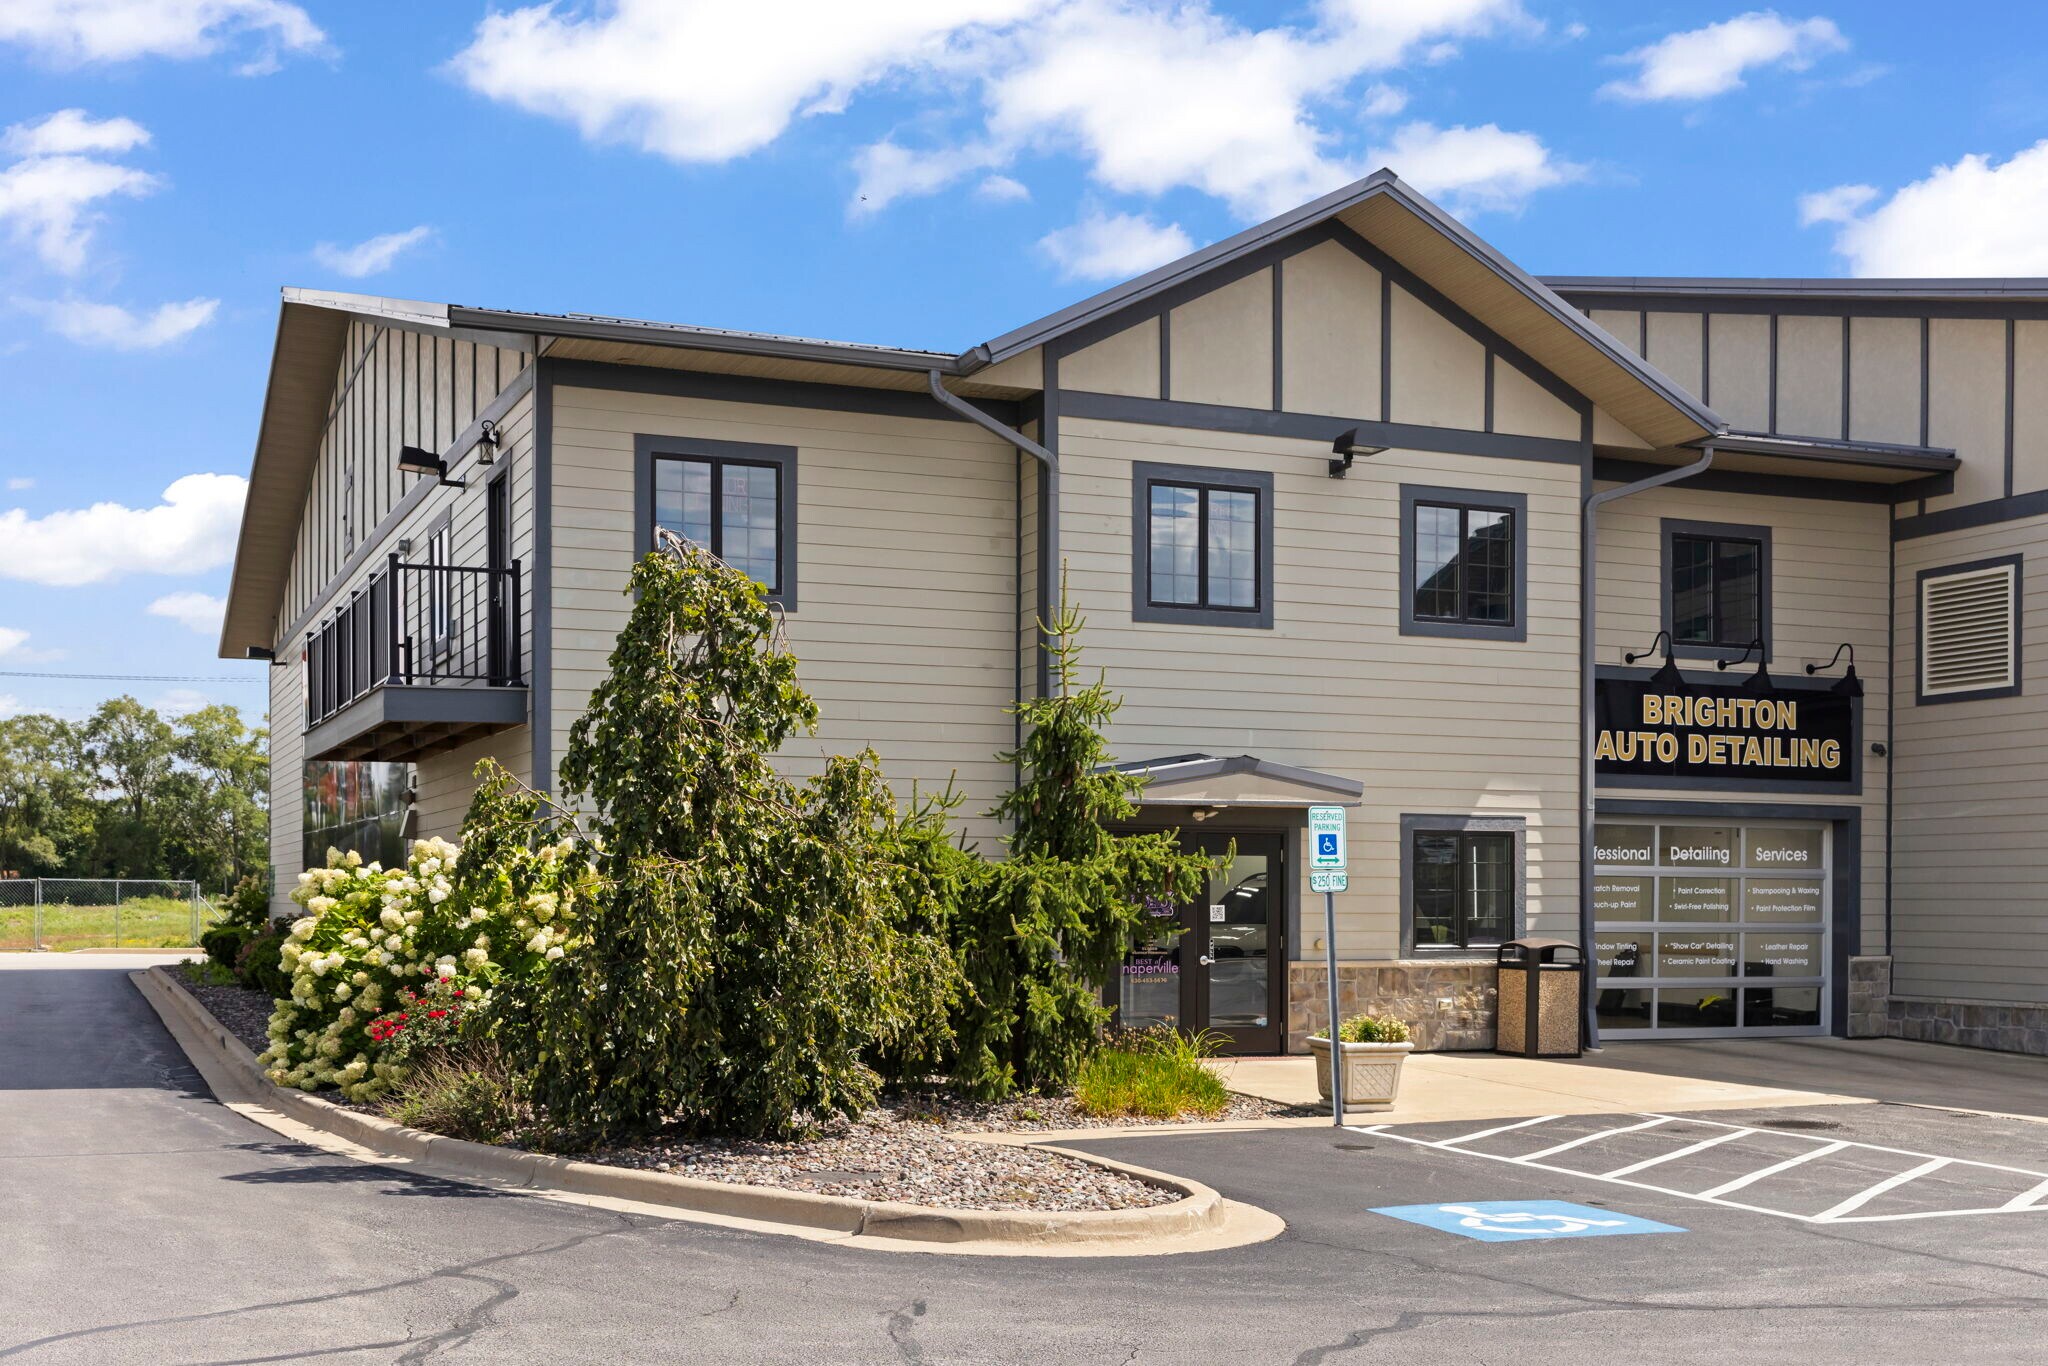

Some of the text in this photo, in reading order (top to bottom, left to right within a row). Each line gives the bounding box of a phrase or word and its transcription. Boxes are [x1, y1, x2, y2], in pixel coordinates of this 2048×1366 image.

[1643, 694, 1796, 730] BRIGHTON
[1594, 730, 1841, 768] AUTO DETAILING
[1311, 813, 1343, 821] RESERVED
[1314, 823, 1341, 831] PARKING
[1594, 846, 1650, 861] fessional
[1670, 846, 1730, 864] Detailing
[1755, 847, 1808, 862] Services
[1332, 875, 1346, 887] FINE
[1752, 887, 1790, 896] Shampooing
[1797, 887, 1820, 896] Waxing
[1594, 900, 1637, 909] ouch-up Paint
[1703, 903, 1729, 911] Polishing
[1756, 904, 1816, 912] Paint Protection Film
[1616, 942, 1637, 951] Tinting
[1706, 942, 1734, 951] Detailing
[1765, 943, 1809, 952] Leather Repair
[1597, 958, 1634, 967] heel Repair
[1695, 957, 1710, 965] Paint
[1711, 957, 1736, 966] Coating
[1765, 957, 1808, 966] Hand Washing
[1122, 961, 1179, 977] naperville
